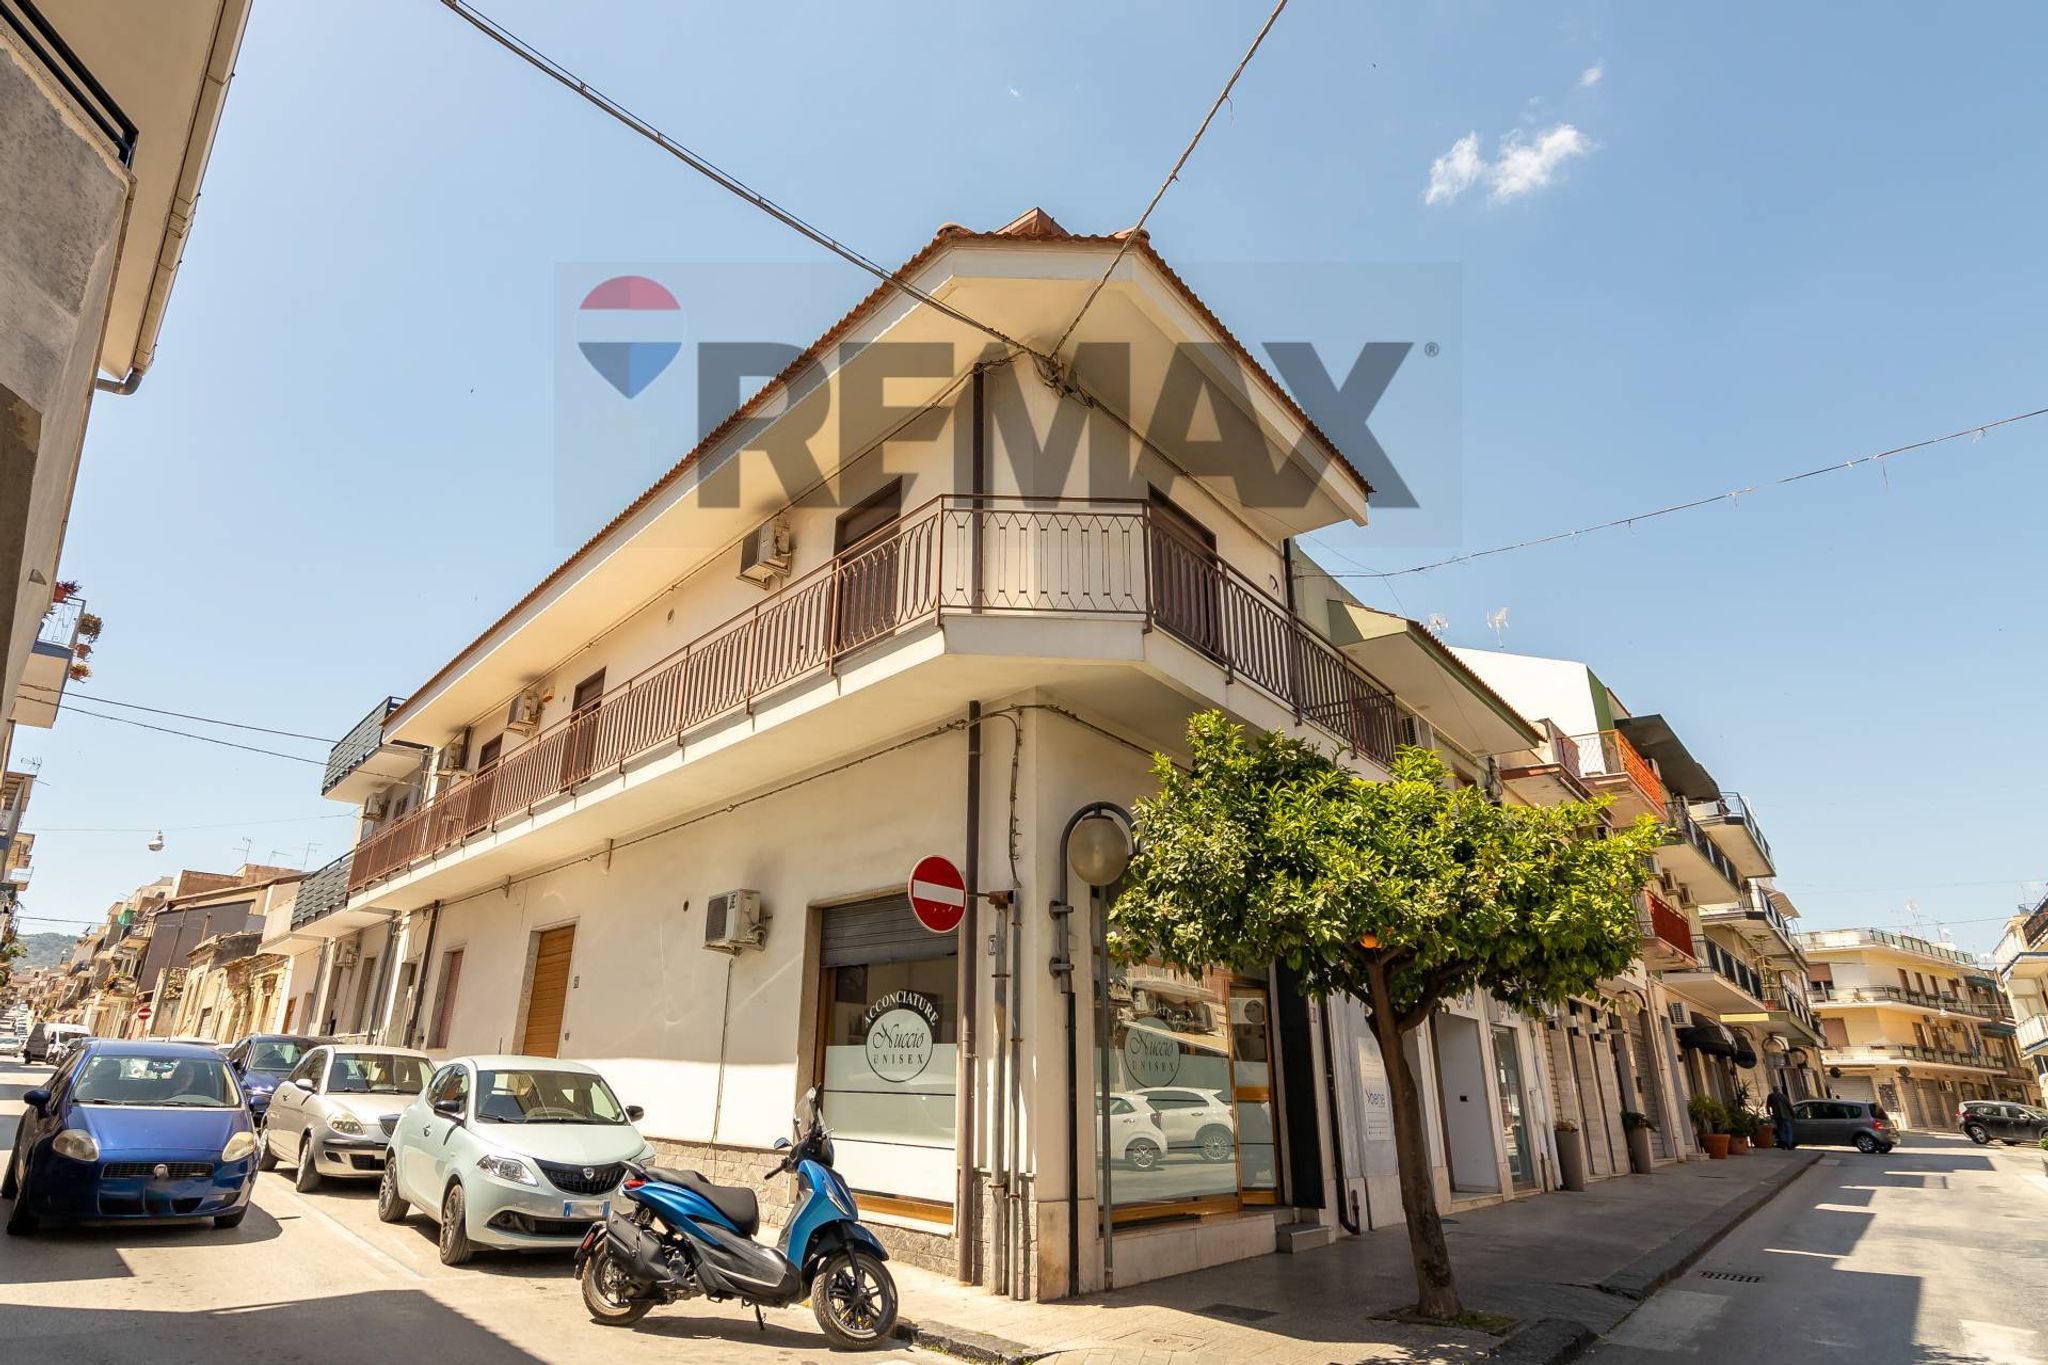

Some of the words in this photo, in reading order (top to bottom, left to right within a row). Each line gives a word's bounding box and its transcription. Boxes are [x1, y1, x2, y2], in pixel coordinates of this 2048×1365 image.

[864, 990, 939, 1028] ACCONCIATURE
[873, 1023, 925, 1049] Nuccio
[873, 1053, 924, 1065] UNISEX
